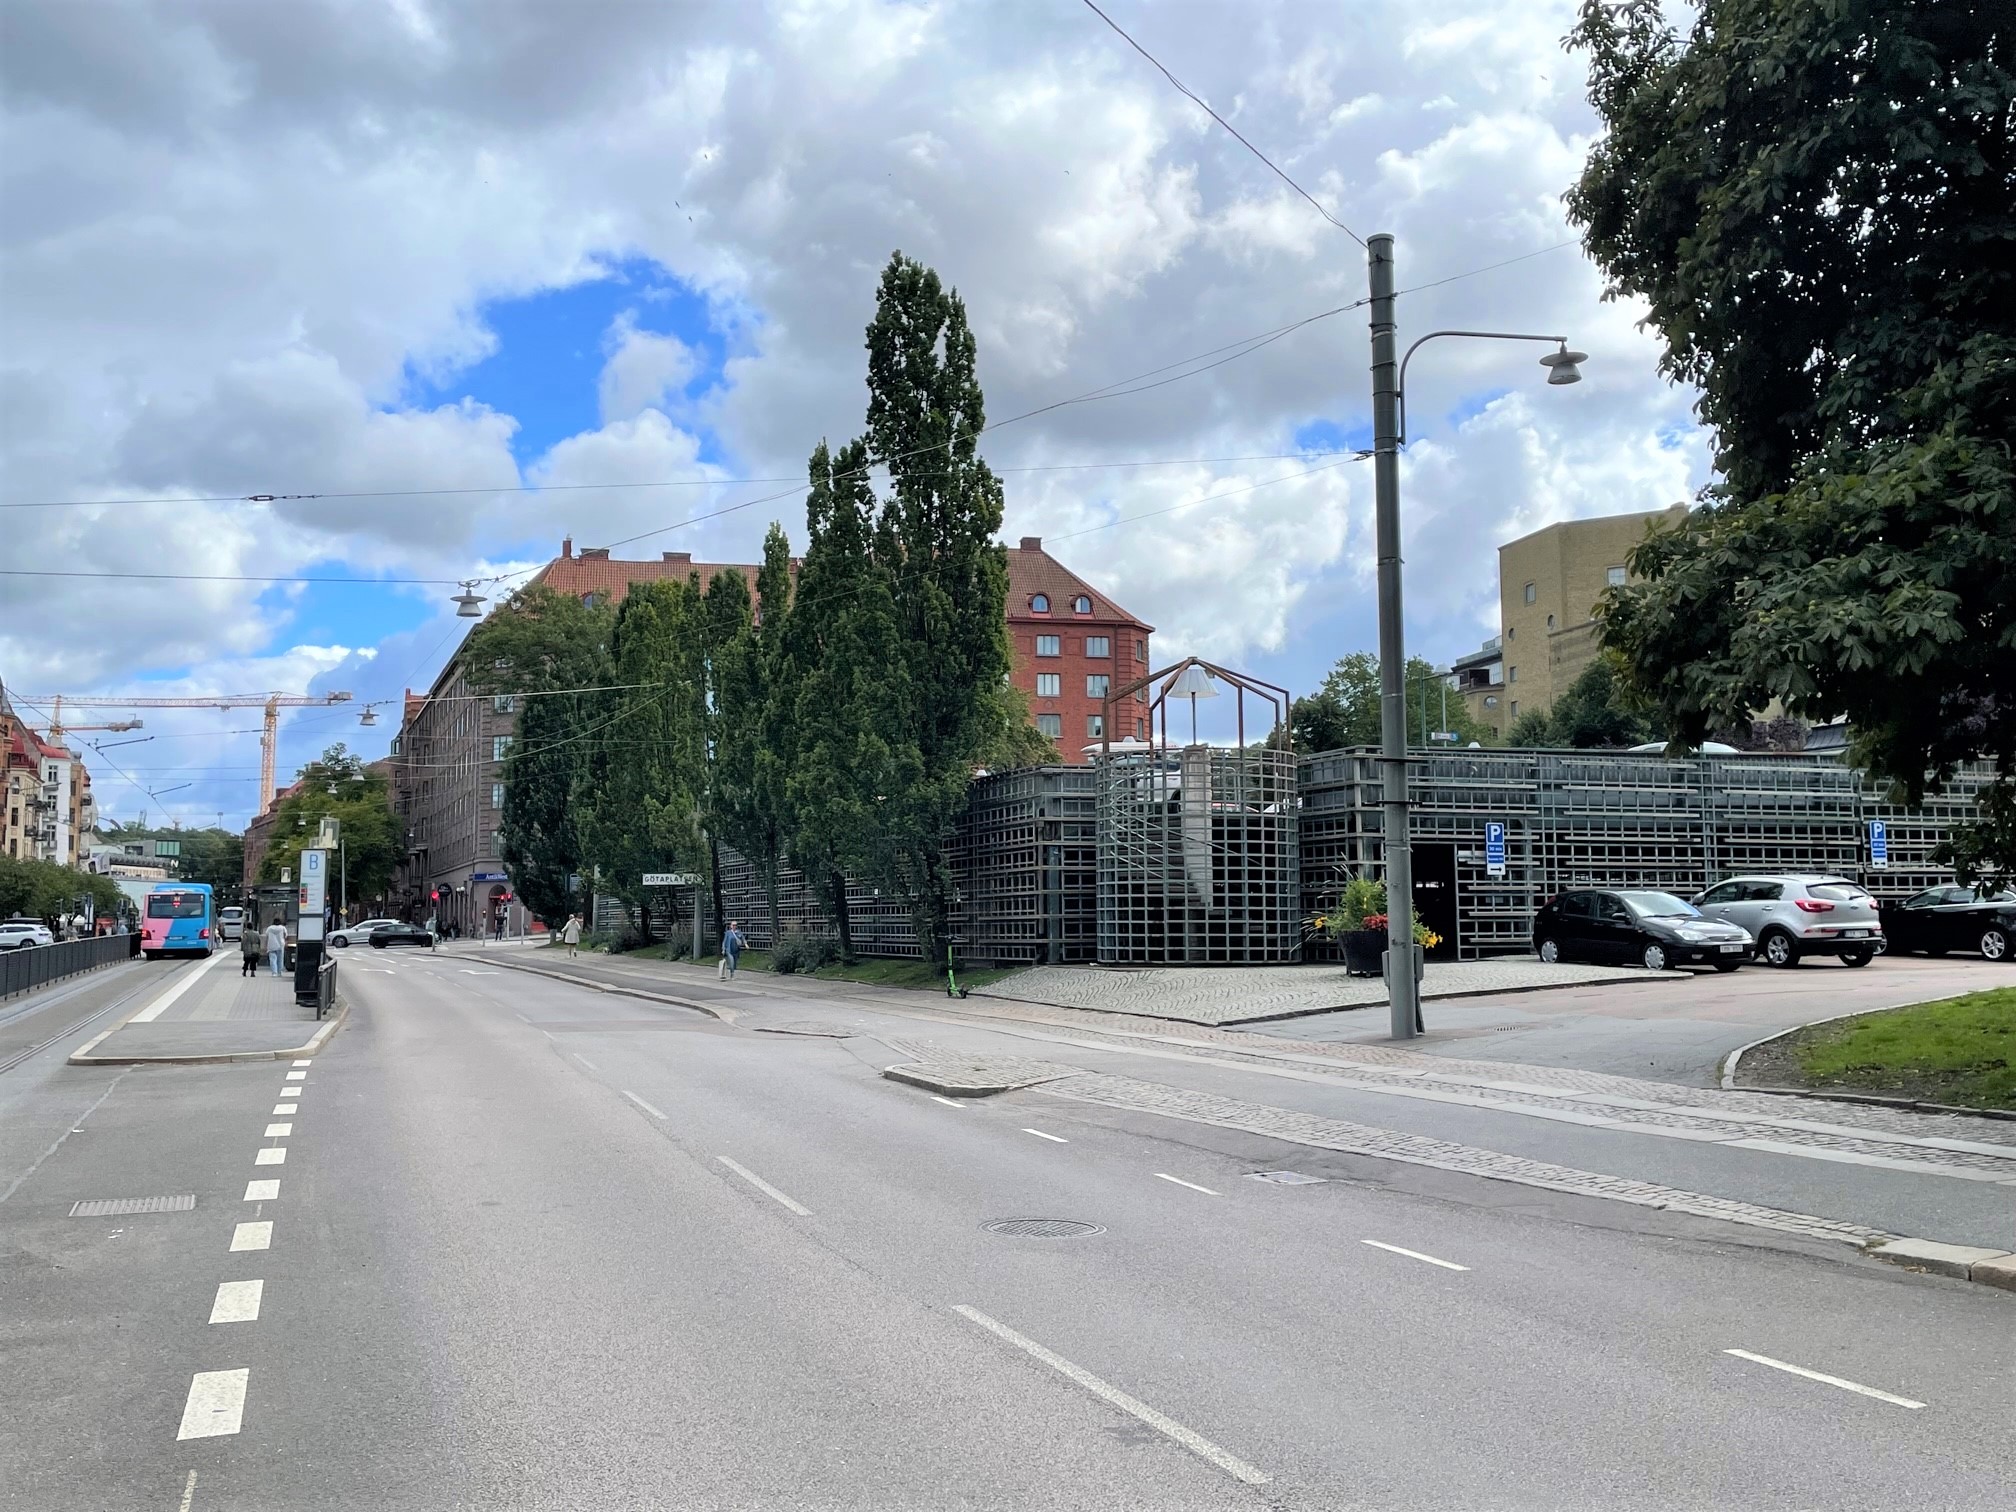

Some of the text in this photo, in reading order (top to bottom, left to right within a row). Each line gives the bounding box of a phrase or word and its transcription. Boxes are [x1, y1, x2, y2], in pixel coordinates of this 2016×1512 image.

[1490, 825, 1501, 841] P
[1873, 822, 1883, 838] P
[309, 854, 319, 870] B
